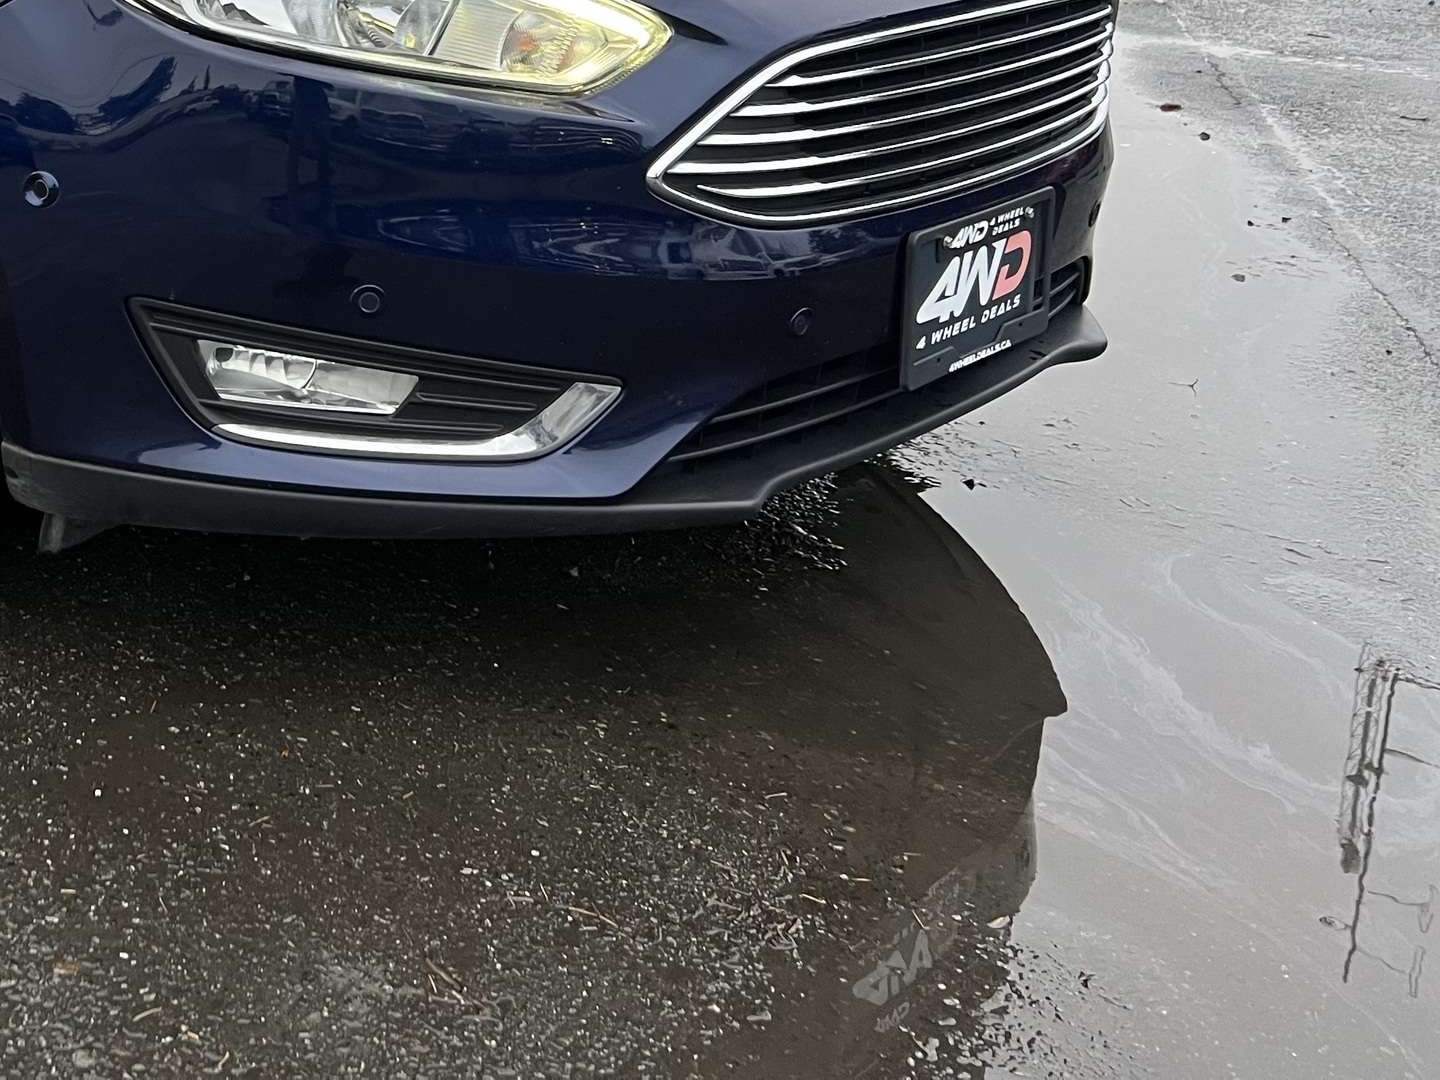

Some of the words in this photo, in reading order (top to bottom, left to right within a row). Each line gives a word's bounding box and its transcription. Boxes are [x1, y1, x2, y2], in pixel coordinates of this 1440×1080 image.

[992, 217, 1021, 236] DEALS
[997, 207, 1025, 224] WHEEL
[916, 230, 1032, 324] 4WD
[915, 335, 927, 350] 4
[931, 314, 977, 345] WHEEL
[981, 293, 1021, 324] DEALS
